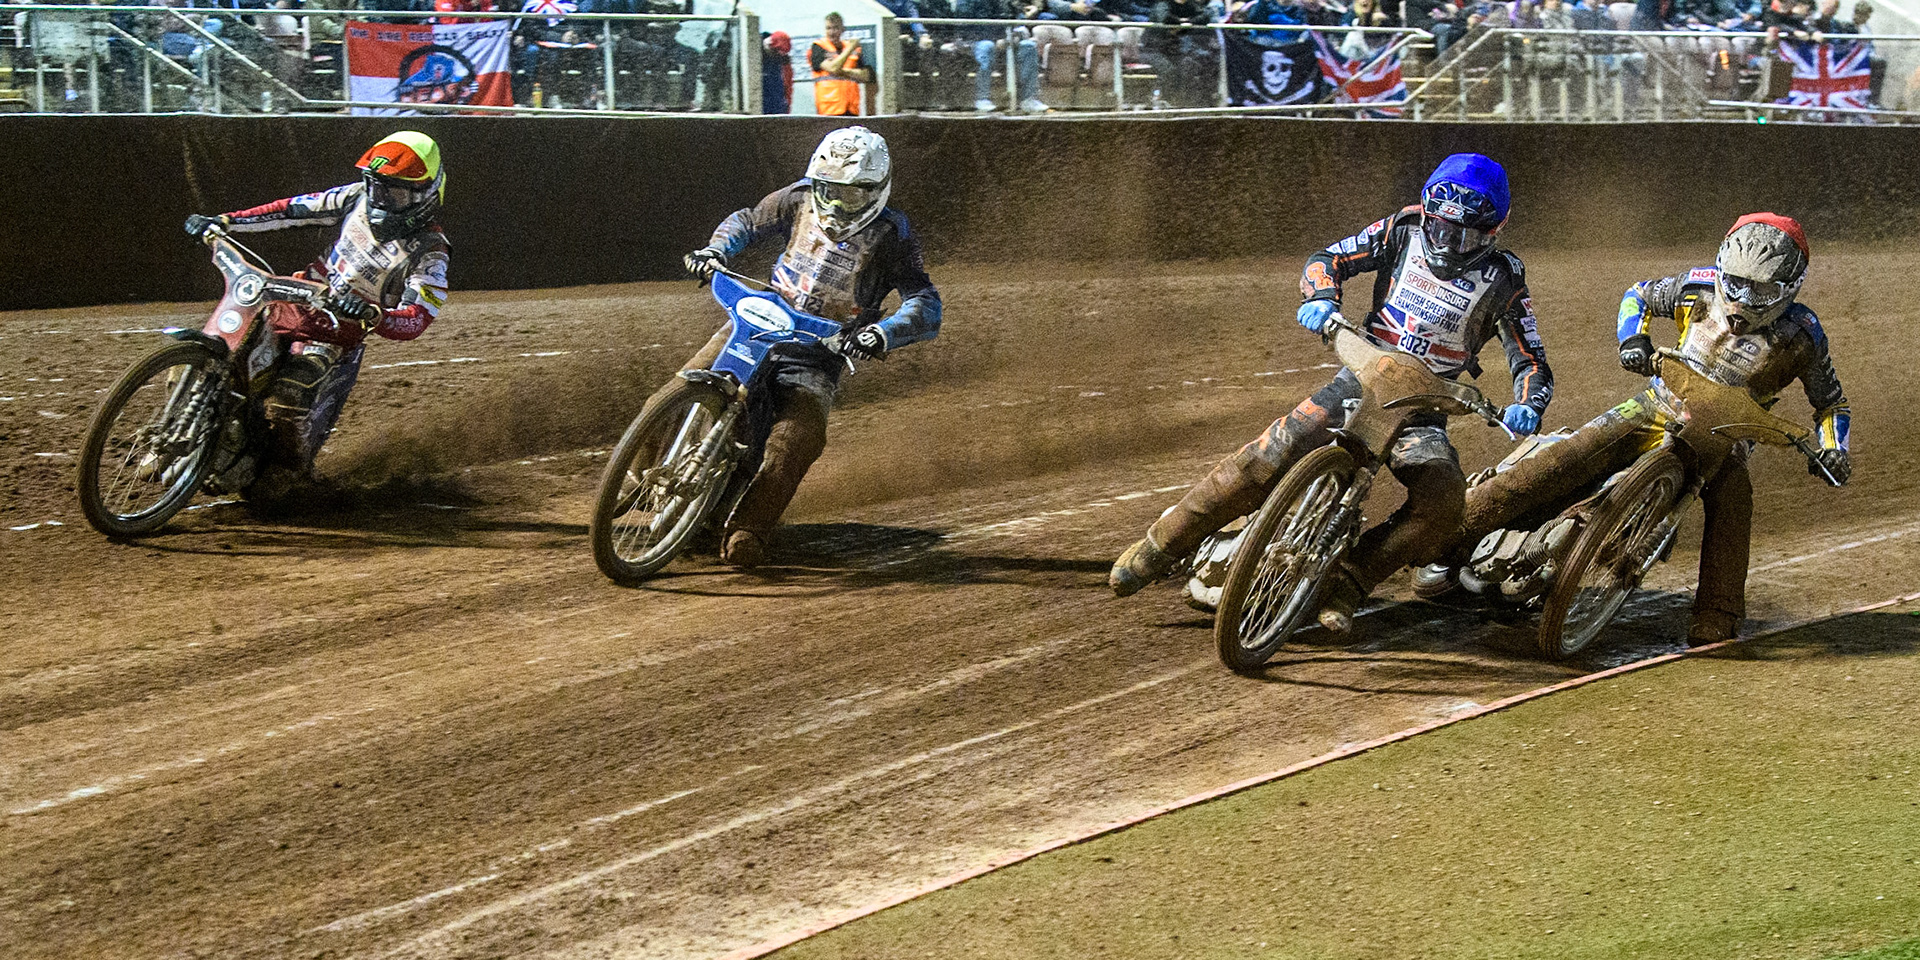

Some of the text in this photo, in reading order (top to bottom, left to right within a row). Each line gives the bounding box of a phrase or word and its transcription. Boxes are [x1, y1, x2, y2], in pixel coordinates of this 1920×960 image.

[1406, 273, 1468, 310] SPORTS INSURE
[1455, 279, 1472, 290] SCB
[1394, 295, 1460, 333] CHAMPIONSHIP FINAL
[1400, 287, 1462, 323] BRITISH SPEEDWAY
[1400, 330, 1431, 356] 2023
